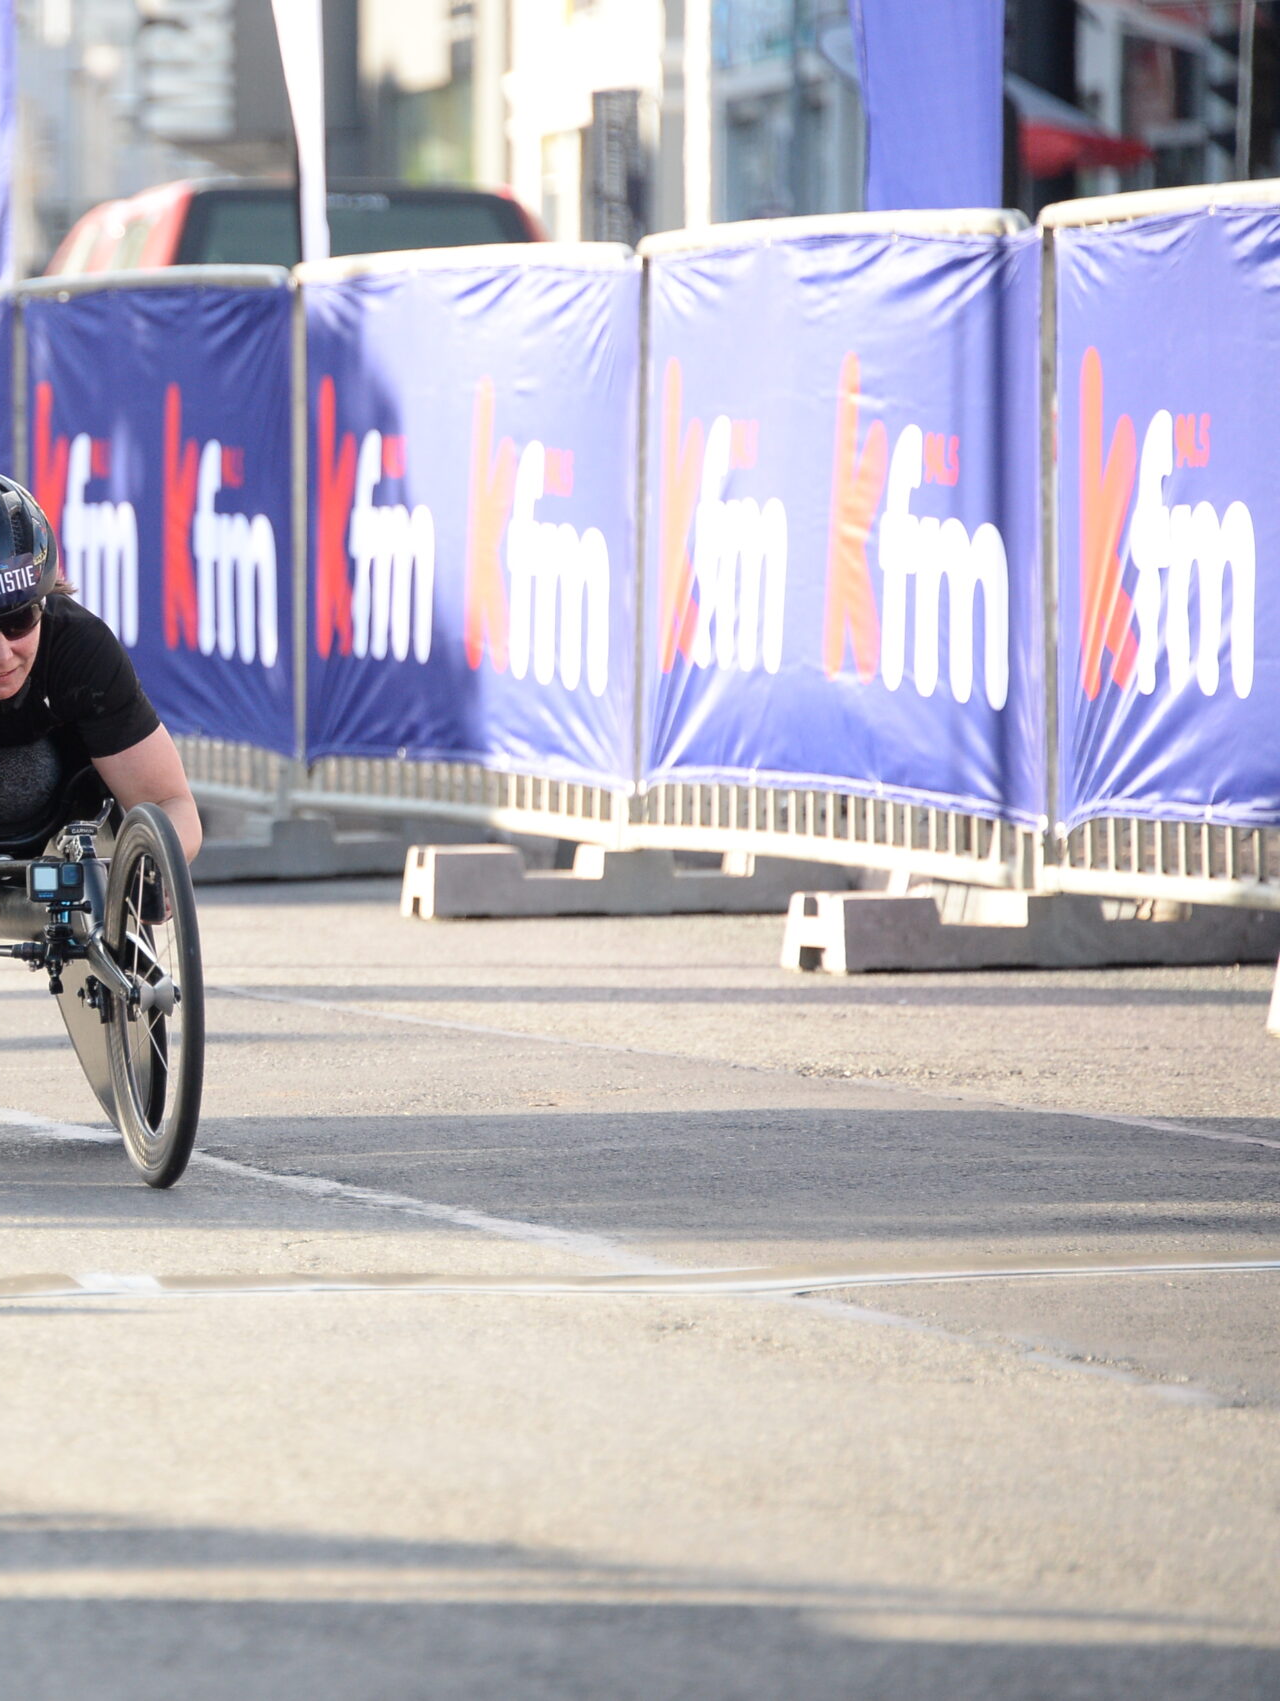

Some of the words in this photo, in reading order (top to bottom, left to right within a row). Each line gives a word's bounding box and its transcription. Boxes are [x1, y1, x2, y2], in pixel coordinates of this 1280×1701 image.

[162, 381, 278, 668] kfm
[316, 374, 435, 664] kfm
[463, 373, 610, 697] kfm
[658, 355, 788, 674] kfm
[822, 350, 1010, 711] kfm
[1078, 345, 1256, 701] kfm
